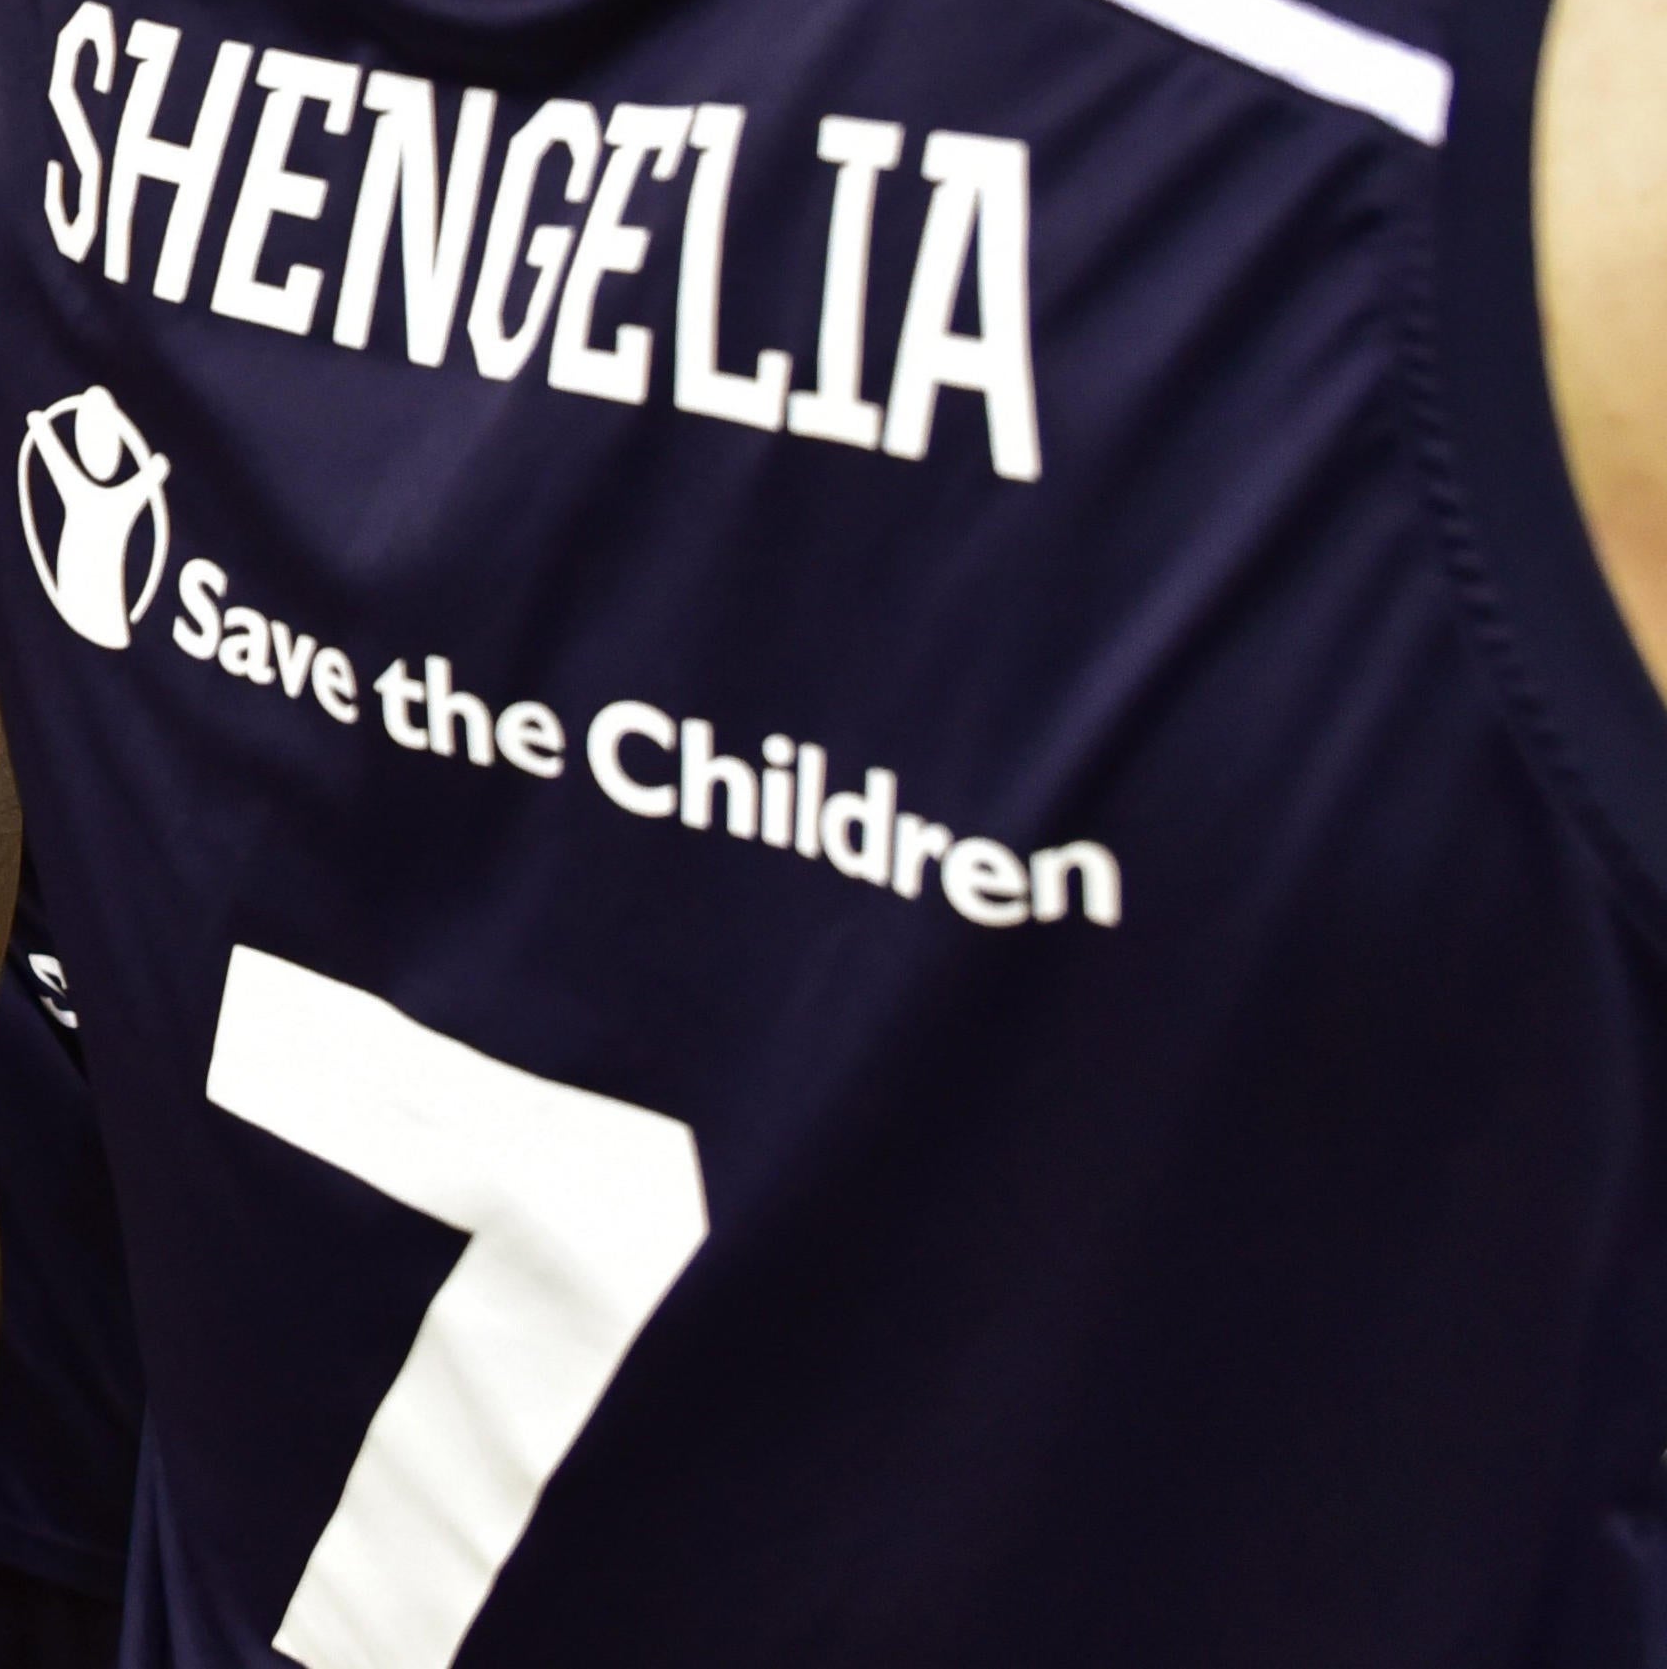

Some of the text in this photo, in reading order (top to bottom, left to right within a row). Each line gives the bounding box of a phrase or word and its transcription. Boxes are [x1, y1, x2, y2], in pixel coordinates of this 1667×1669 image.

[43, 0, 1043, 483] SHENGELIA
[172, 558, 1122, 927] Save the Children
[206, 944, 710, 1669] 7
